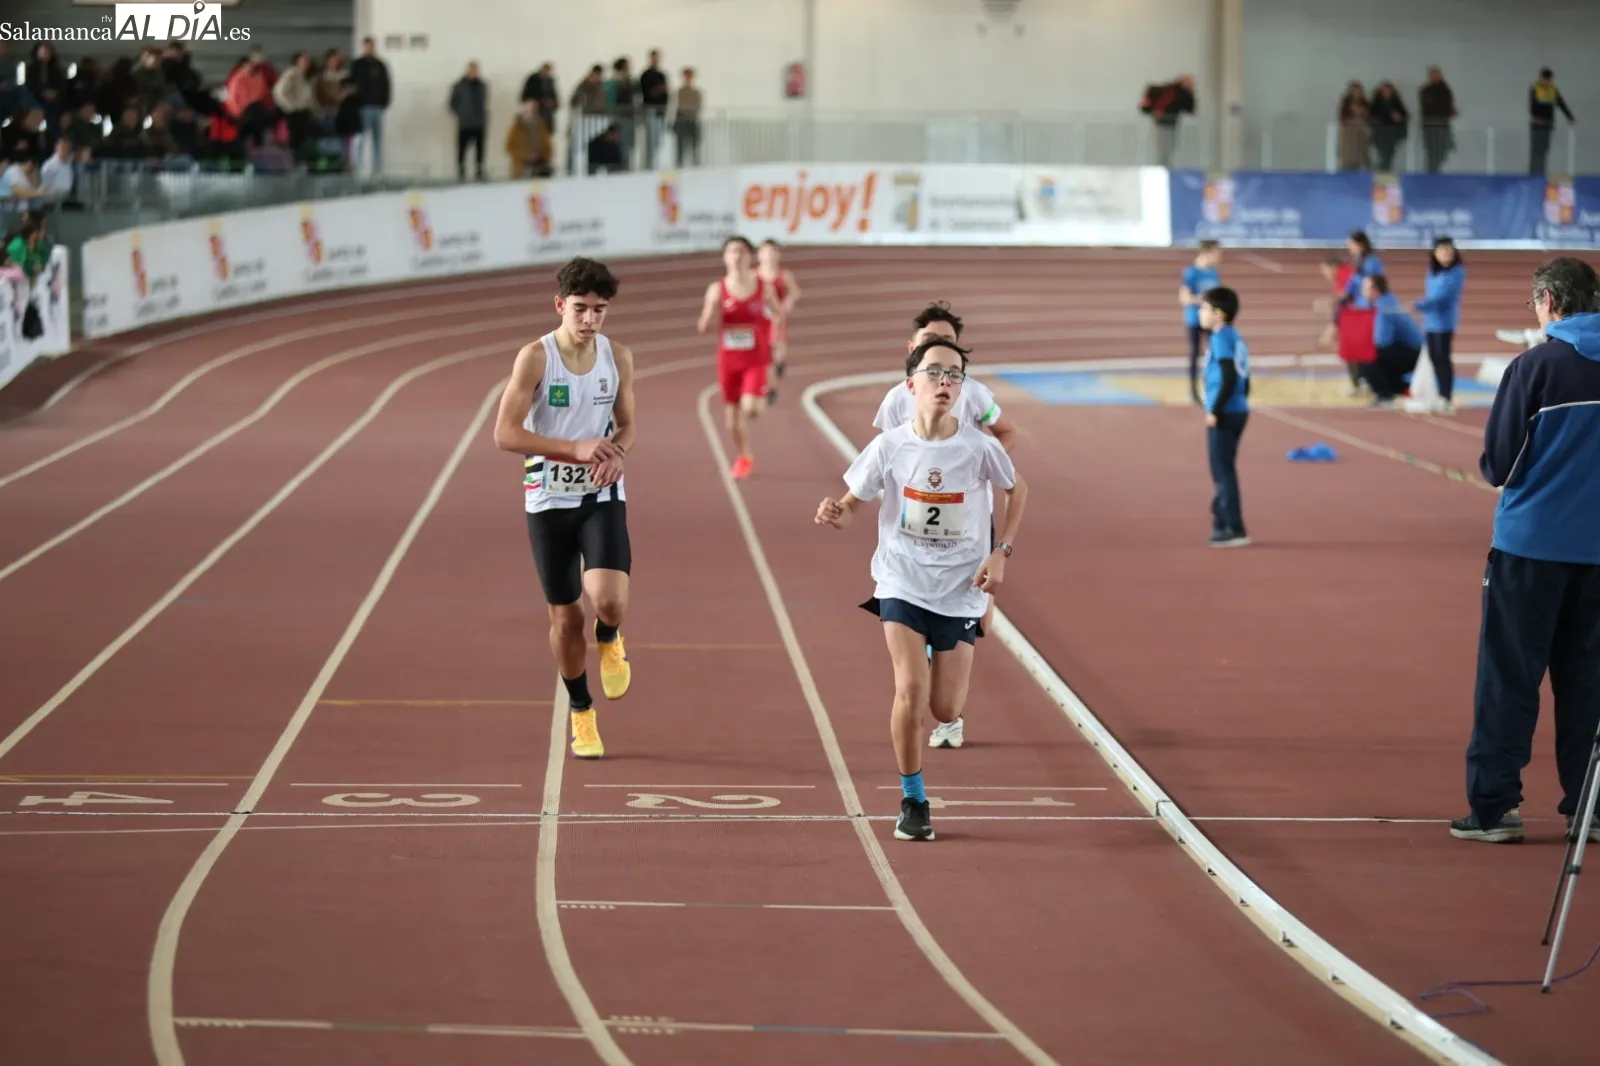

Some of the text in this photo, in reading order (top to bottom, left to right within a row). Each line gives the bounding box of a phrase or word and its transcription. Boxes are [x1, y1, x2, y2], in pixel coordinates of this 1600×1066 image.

[741, 171, 879, 234] enjoy!
[926, 506, 941, 526] 2
[18, 791, 175, 806] 4
[321, 792, 481, 808] 3
[625, 793, 782, 809] 2
